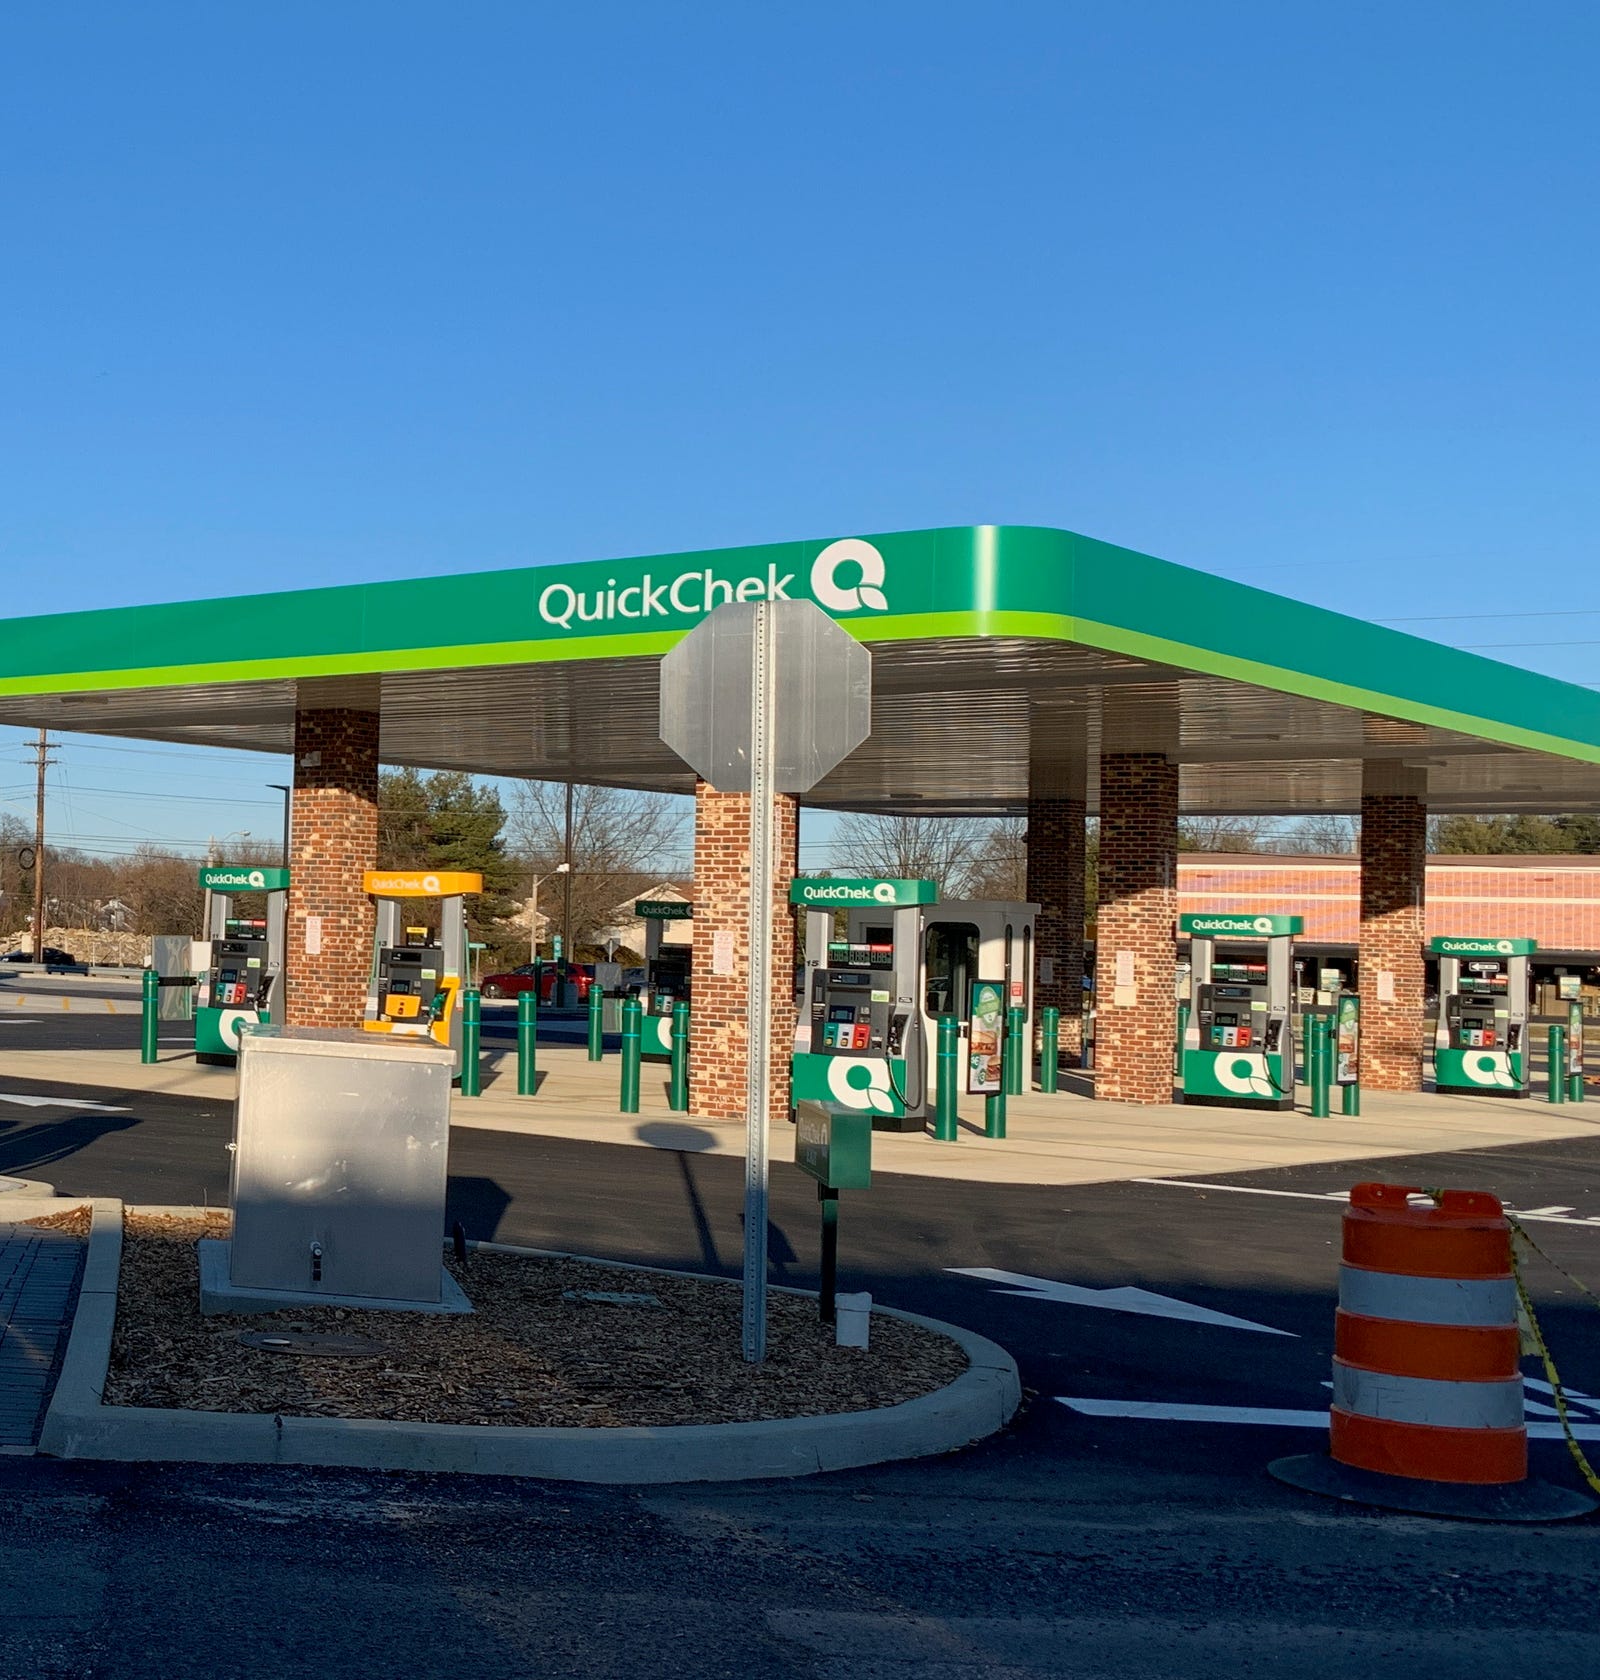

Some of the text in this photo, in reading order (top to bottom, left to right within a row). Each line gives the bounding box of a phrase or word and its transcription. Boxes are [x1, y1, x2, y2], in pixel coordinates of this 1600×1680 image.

[539, 563, 795, 629] QuickChek
[205, 873, 248, 884] QuickChek
[372, 878, 420, 890] QuickChek
[803, 885, 872, 900] QuickChek
[642, 905, 685, 916] QuickChek
[1192, 919, 1252, 931] QuickChek
[1442, 941, 1495, 951] QuickChek
